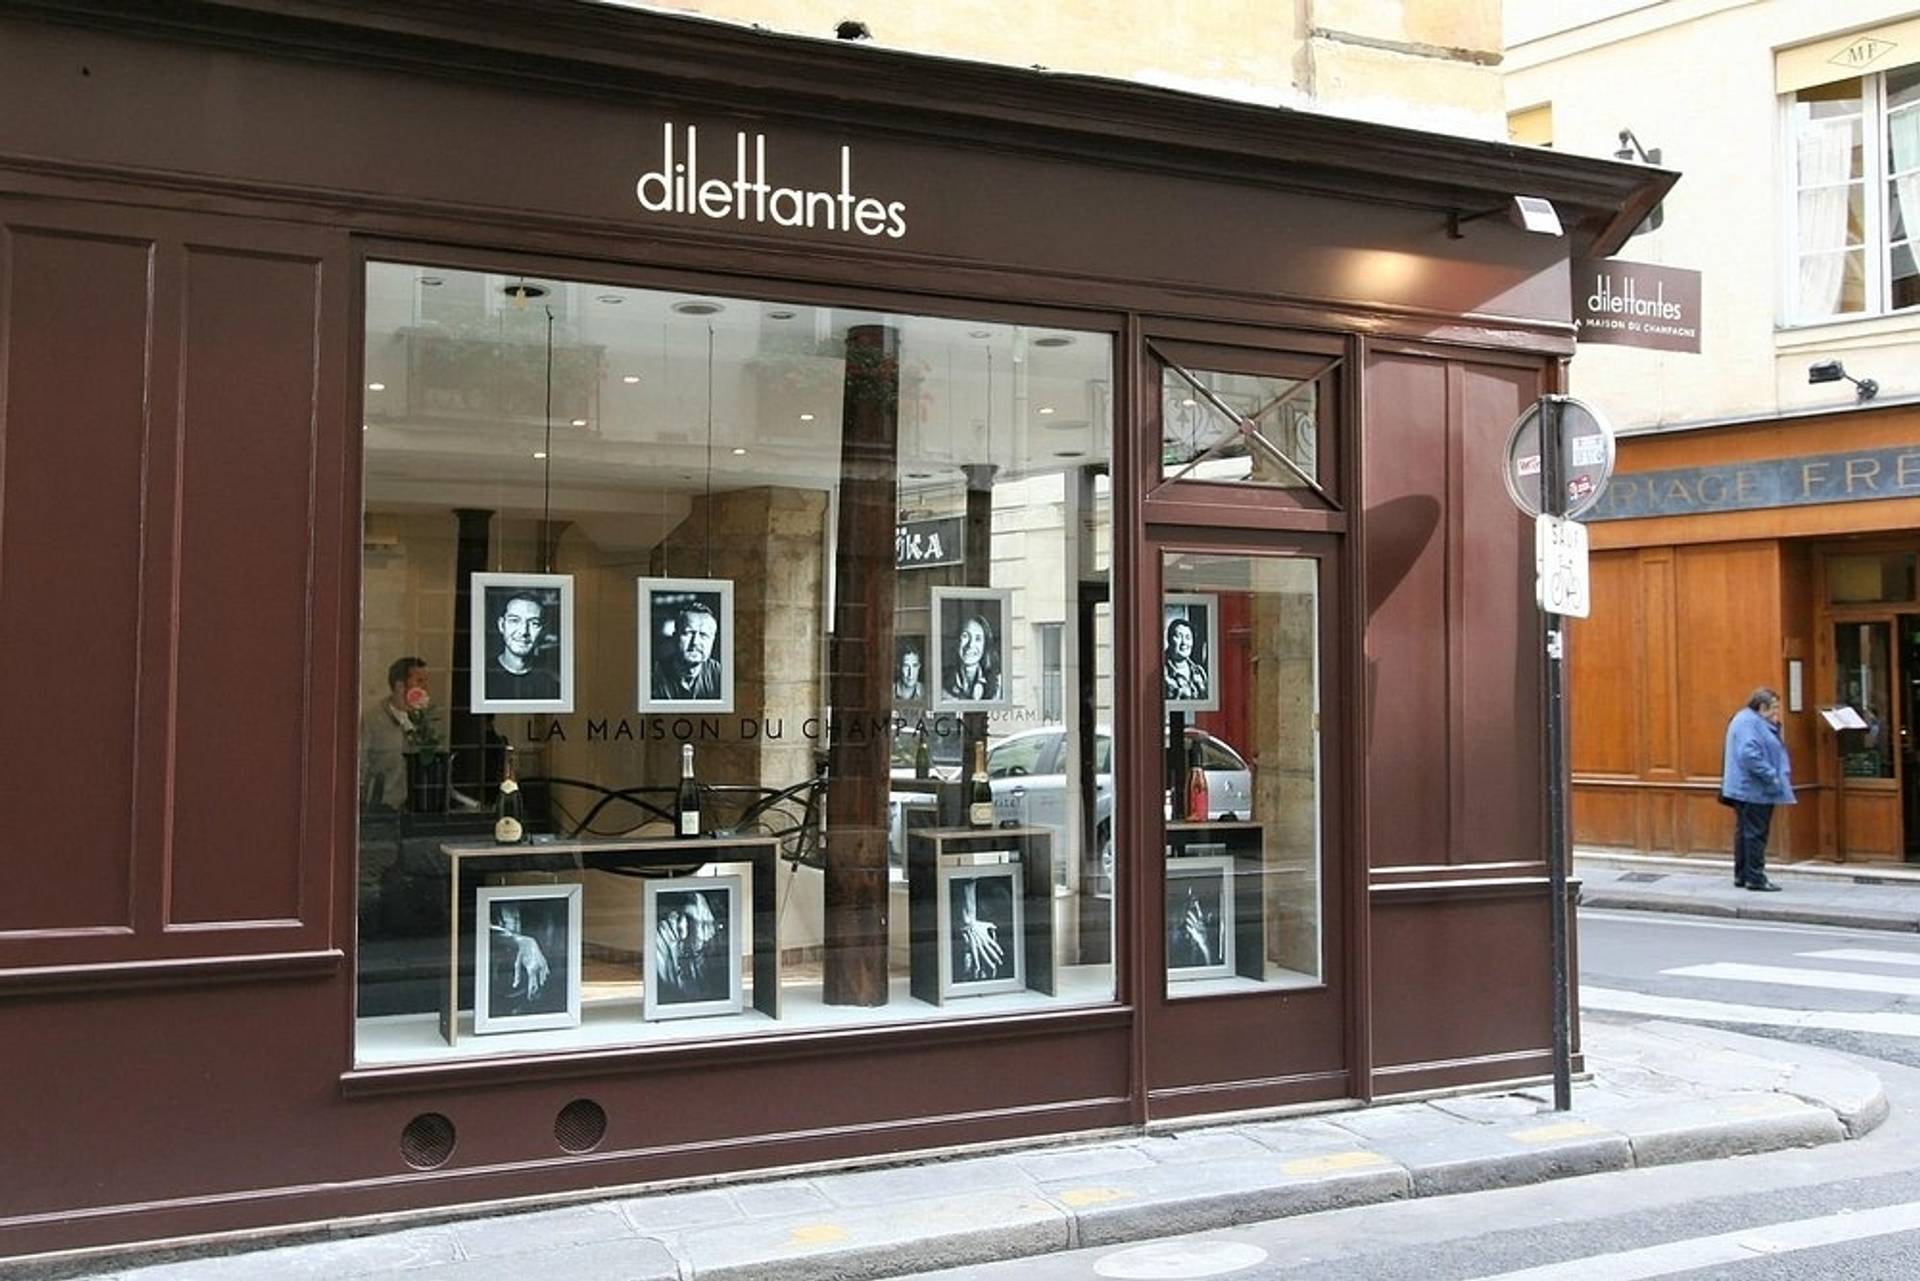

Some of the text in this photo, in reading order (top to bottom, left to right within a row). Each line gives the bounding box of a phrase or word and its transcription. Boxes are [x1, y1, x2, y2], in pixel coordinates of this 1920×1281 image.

[1848, 43, 1877, 63] MF
[636, 122, 906, 238] dilettantes
[1588, 274, 1681, 320] dilettantes
[1586, 319, 1627, 331] MAISON
[1628, 322, 1642, 334] DU
[1644, 324, 1697, 339] CHAMPAGNE
[1595, 470, 1761, 512] RIAGE
[527, 716, 990, 742] LA MAISON DU CHAMPAGNE
